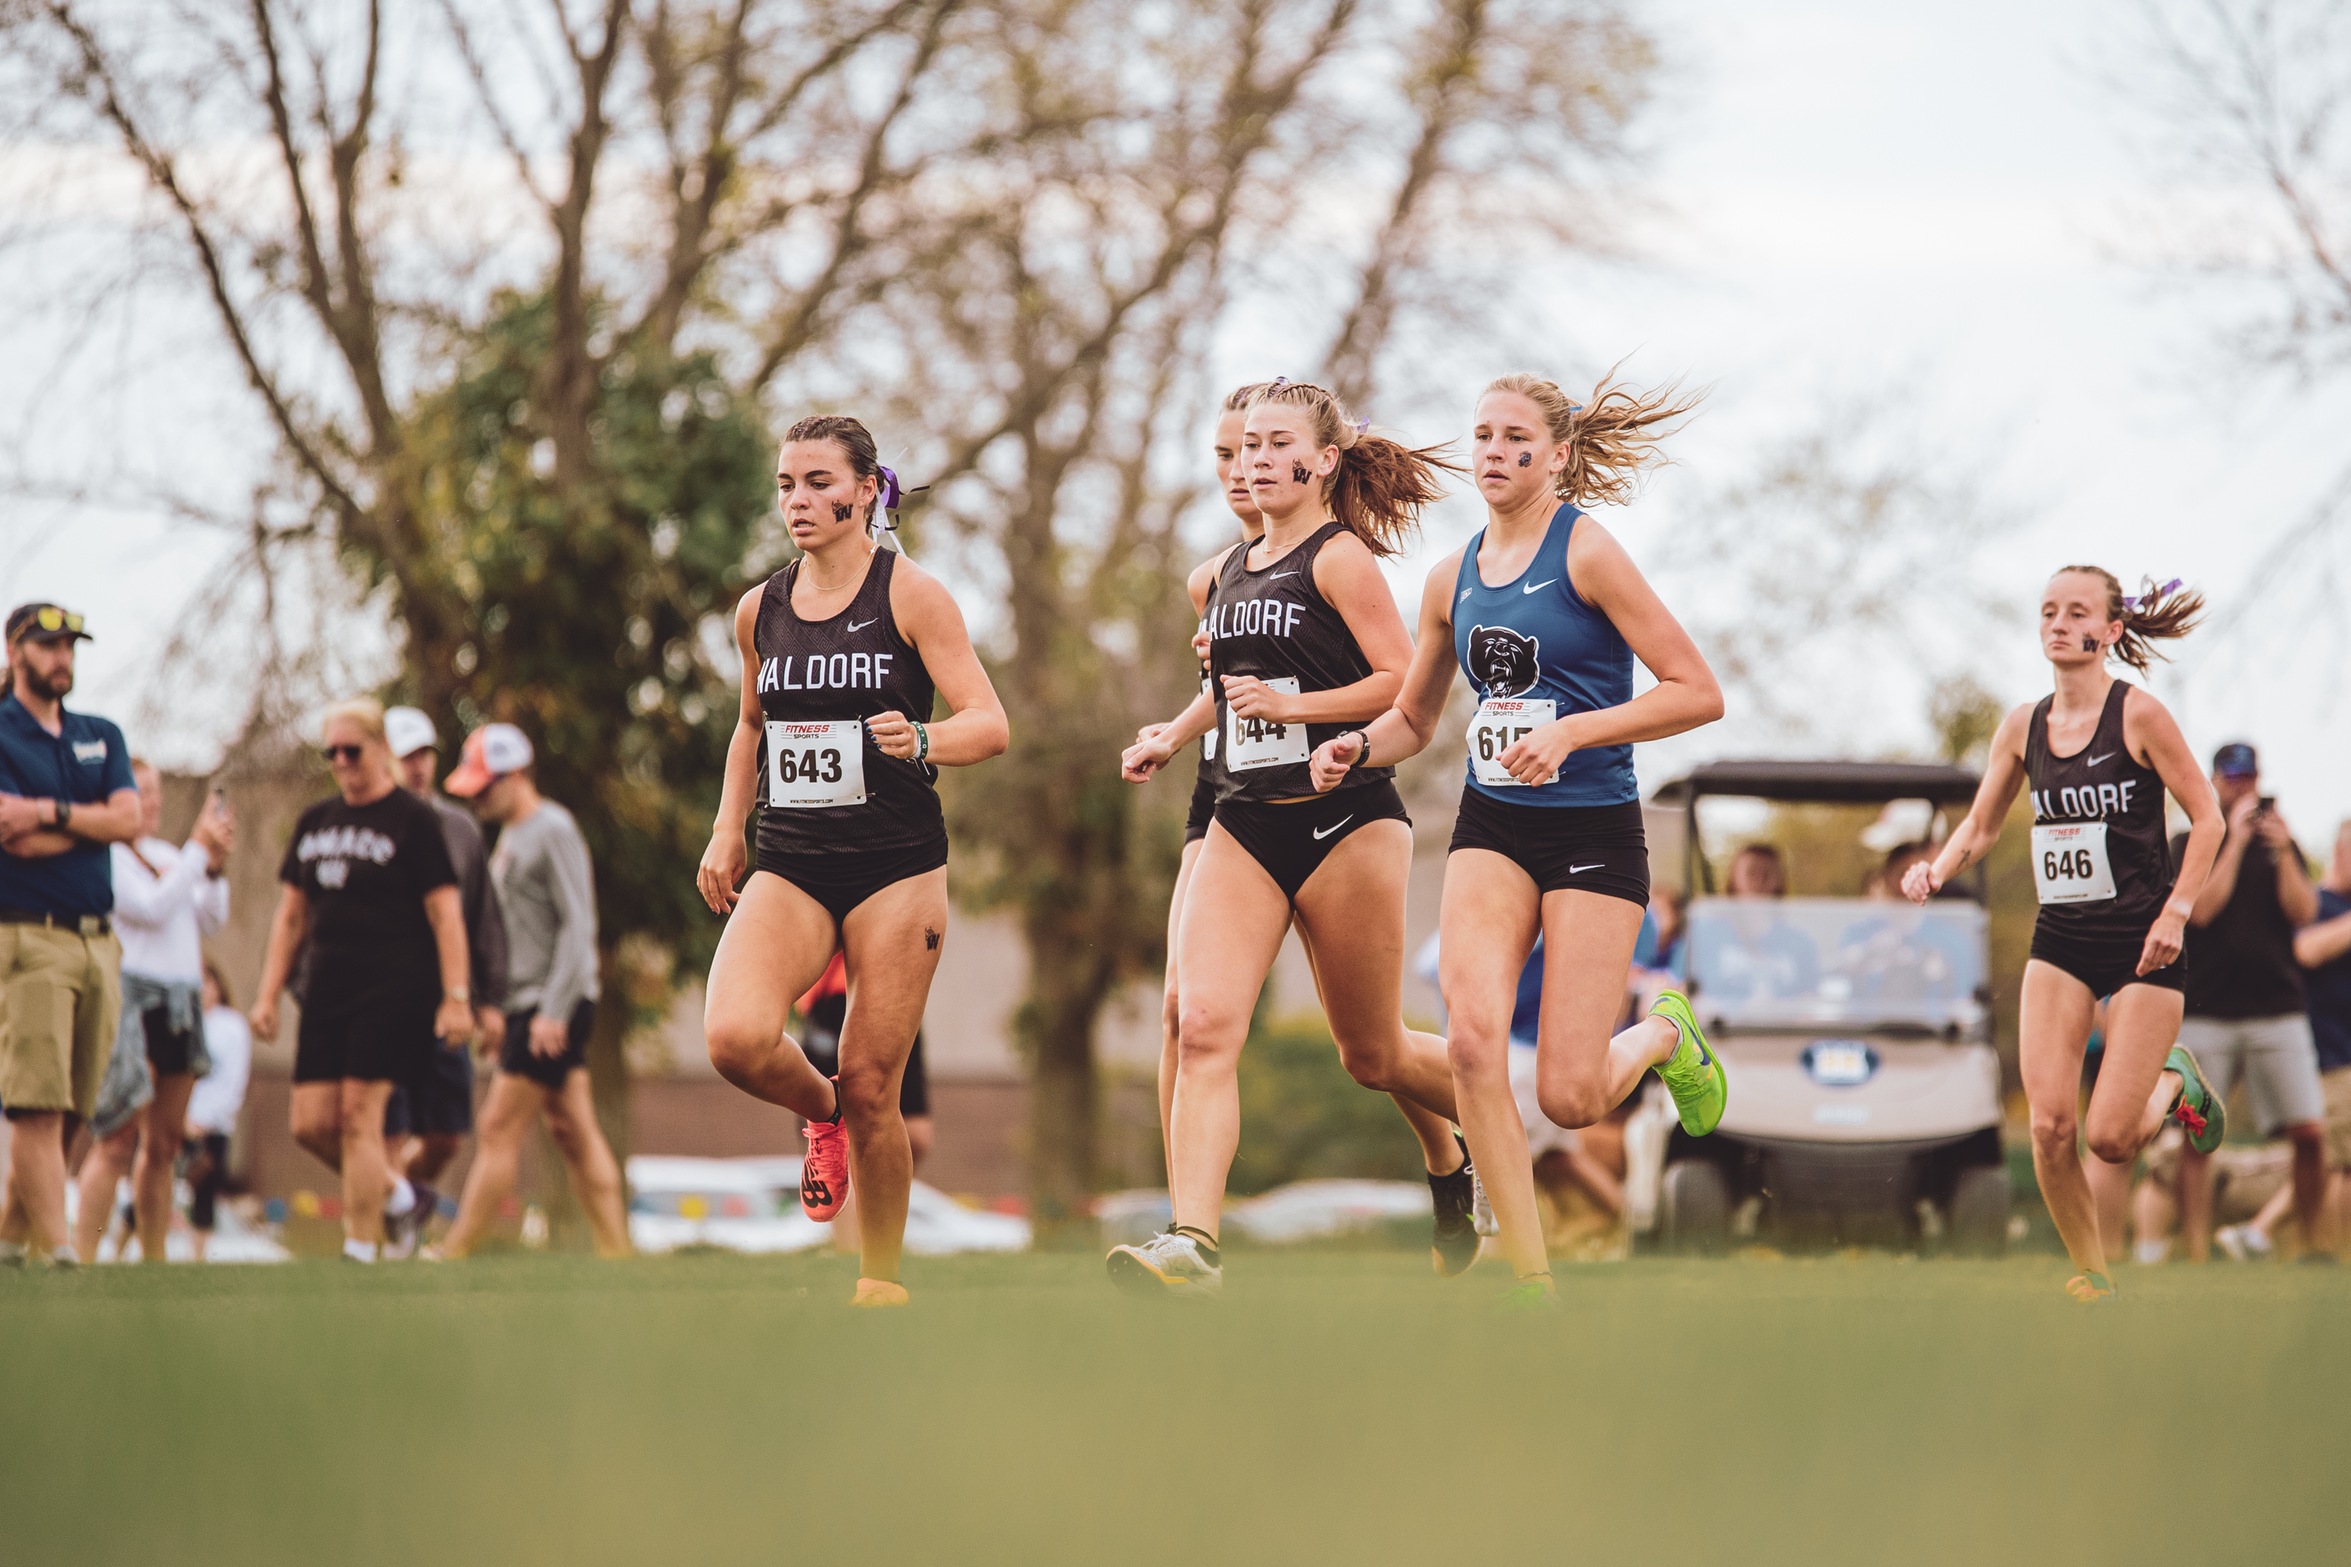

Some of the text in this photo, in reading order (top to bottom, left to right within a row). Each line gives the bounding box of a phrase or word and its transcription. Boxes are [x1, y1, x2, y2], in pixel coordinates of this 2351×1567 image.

[1209, 598, 1306, 641] ALDORF
[1485, 701, 1524, 710] FITNESS
[785, 724, 830, 733] FITNESS
[780, 748, 843, 784] 643
[2030, 780, 2137, 820] ALDORF
[2044, 849, 2093, 881] 646
